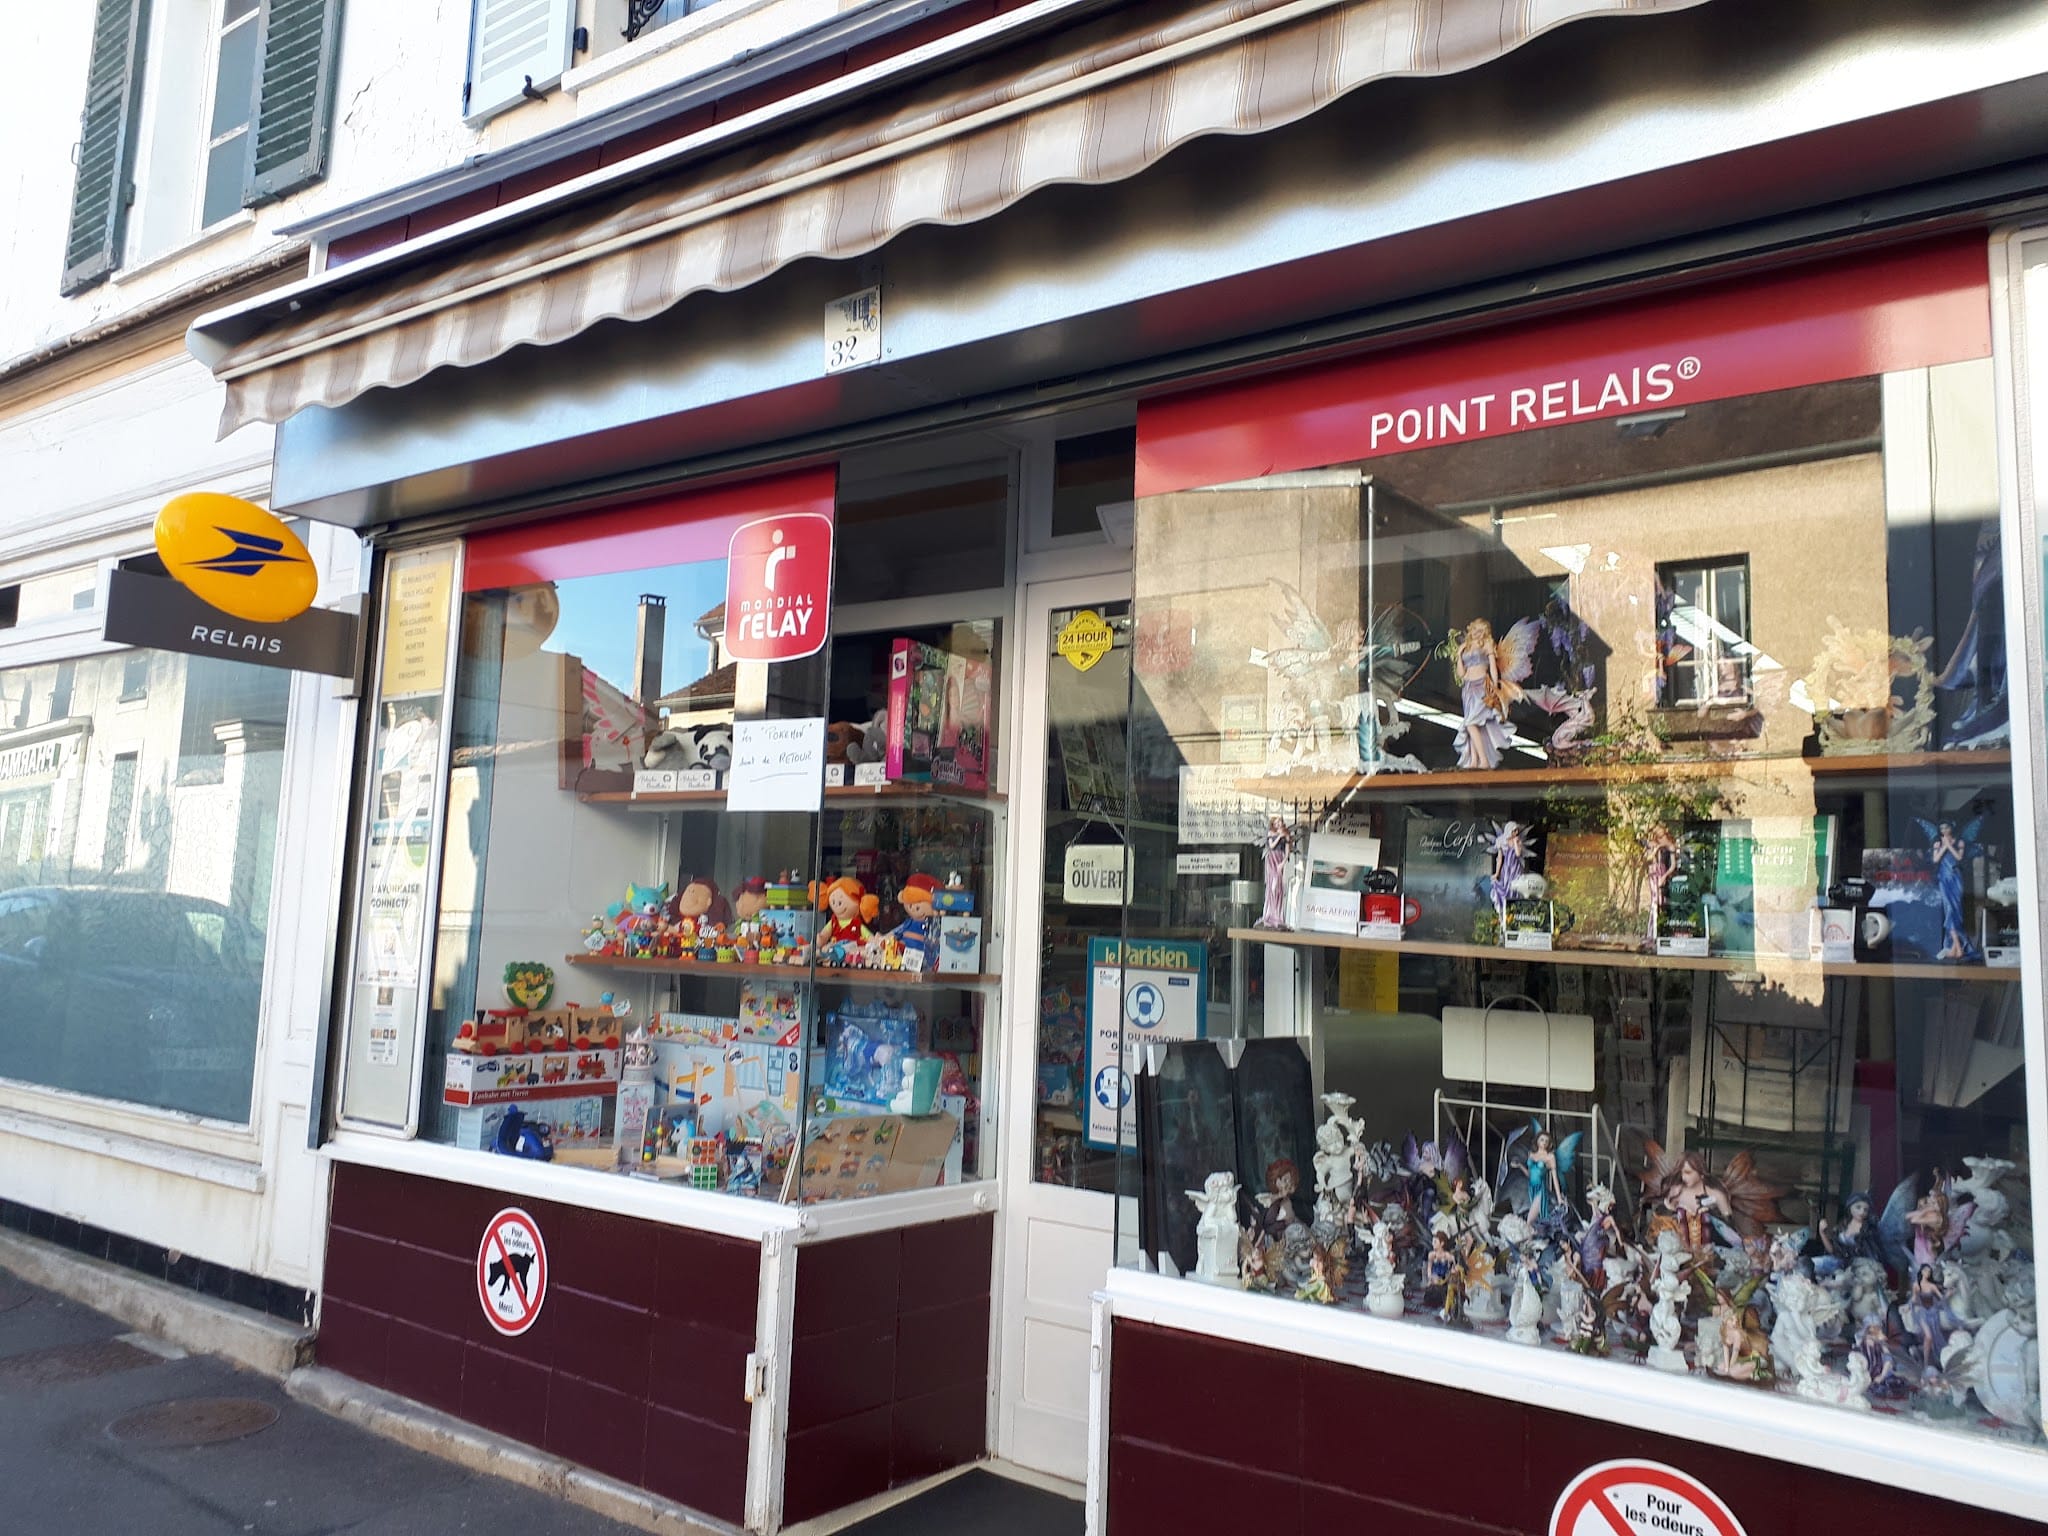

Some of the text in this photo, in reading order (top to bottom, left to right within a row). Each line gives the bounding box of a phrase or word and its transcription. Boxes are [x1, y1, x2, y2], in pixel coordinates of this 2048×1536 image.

[831, 335, 858, 367] 32
[1370, 394, 1496, 450] POINT
[740, 593, 813, 613] MONDIAL
[191, 624, 282, 654] RELAIS
[1062, 631, 1107, 645] 24 HOUR
[779, 751, 812, 765] RETOUR
[1072, 858, 1094, 868] C'est
[1072, 870, 1124, 888] OUVERT
[1105, 941, 1189, 969] le Parisien
[1100, 1029, 1121, 1040] POR
[1127, 1033, 1141, 1041] DU
[503, 1236, 512, 1247] les
[511, 1227, 523, 1238] Pour
[1647, 1493, 1683, 1515] Pour
[1625, 1504, 1704, 1536] les odeurs
